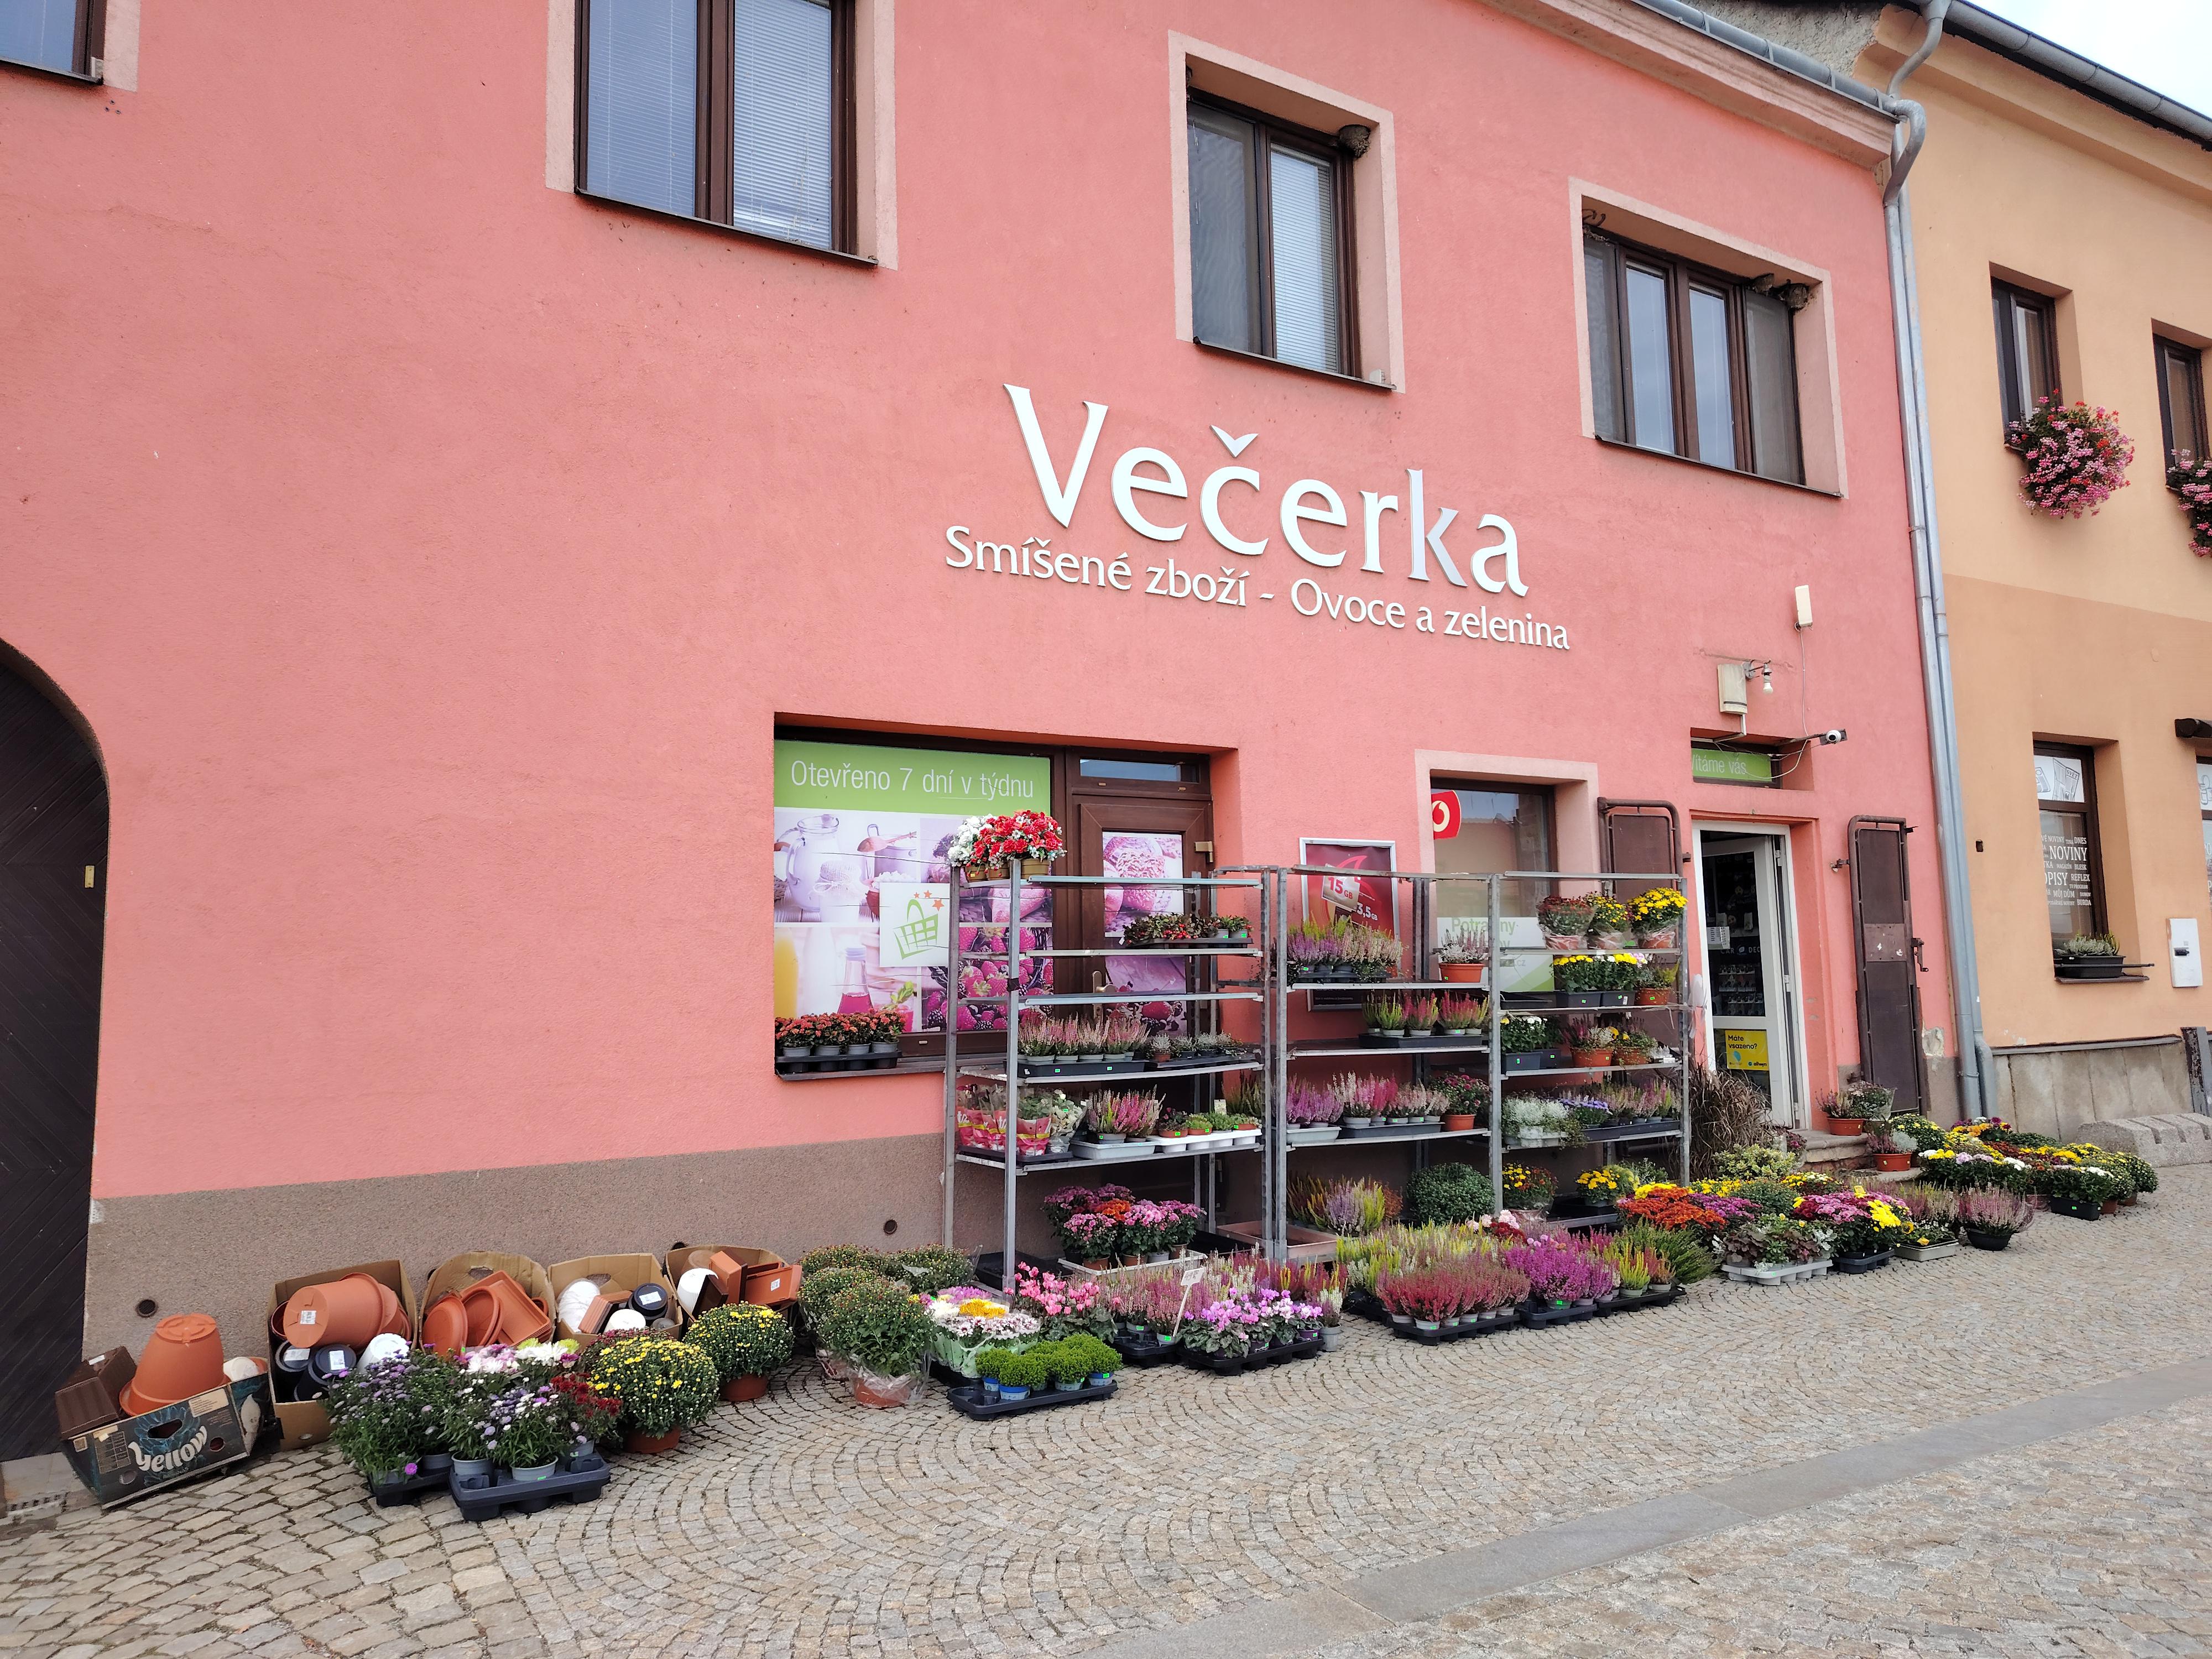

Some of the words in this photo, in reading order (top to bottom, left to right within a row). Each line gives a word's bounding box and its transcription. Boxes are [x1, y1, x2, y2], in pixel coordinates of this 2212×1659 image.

[1003, 384, 1529, 597] Večerka
[946, 526, 1132, 591] Smíšené
[1145, 558, 1250, 607] zboží
[1291, 578, 1406, 628] Ovoce
[1417, 607, 1435, 632] a
[1444, 606, 1571, 650] zelenina
[1729, 758, 1746, 775] vás
[791, 760, 890, 791] Otevřeno
[899, 768, 913, 791] 7
[922, 769, 954, 794] dní
[961, 776, 972, 794] v
[979, 773, 1034, 801] týdnu
[2048, 835, 2064, 843] NOVINY
[2049, 846, 2088, 861] NOVINY
[1328, 877, 1343, 894] 15
[2071, 873, 2090, 882] REFLEX
[1452, 917, 1515, 935] Potrany
